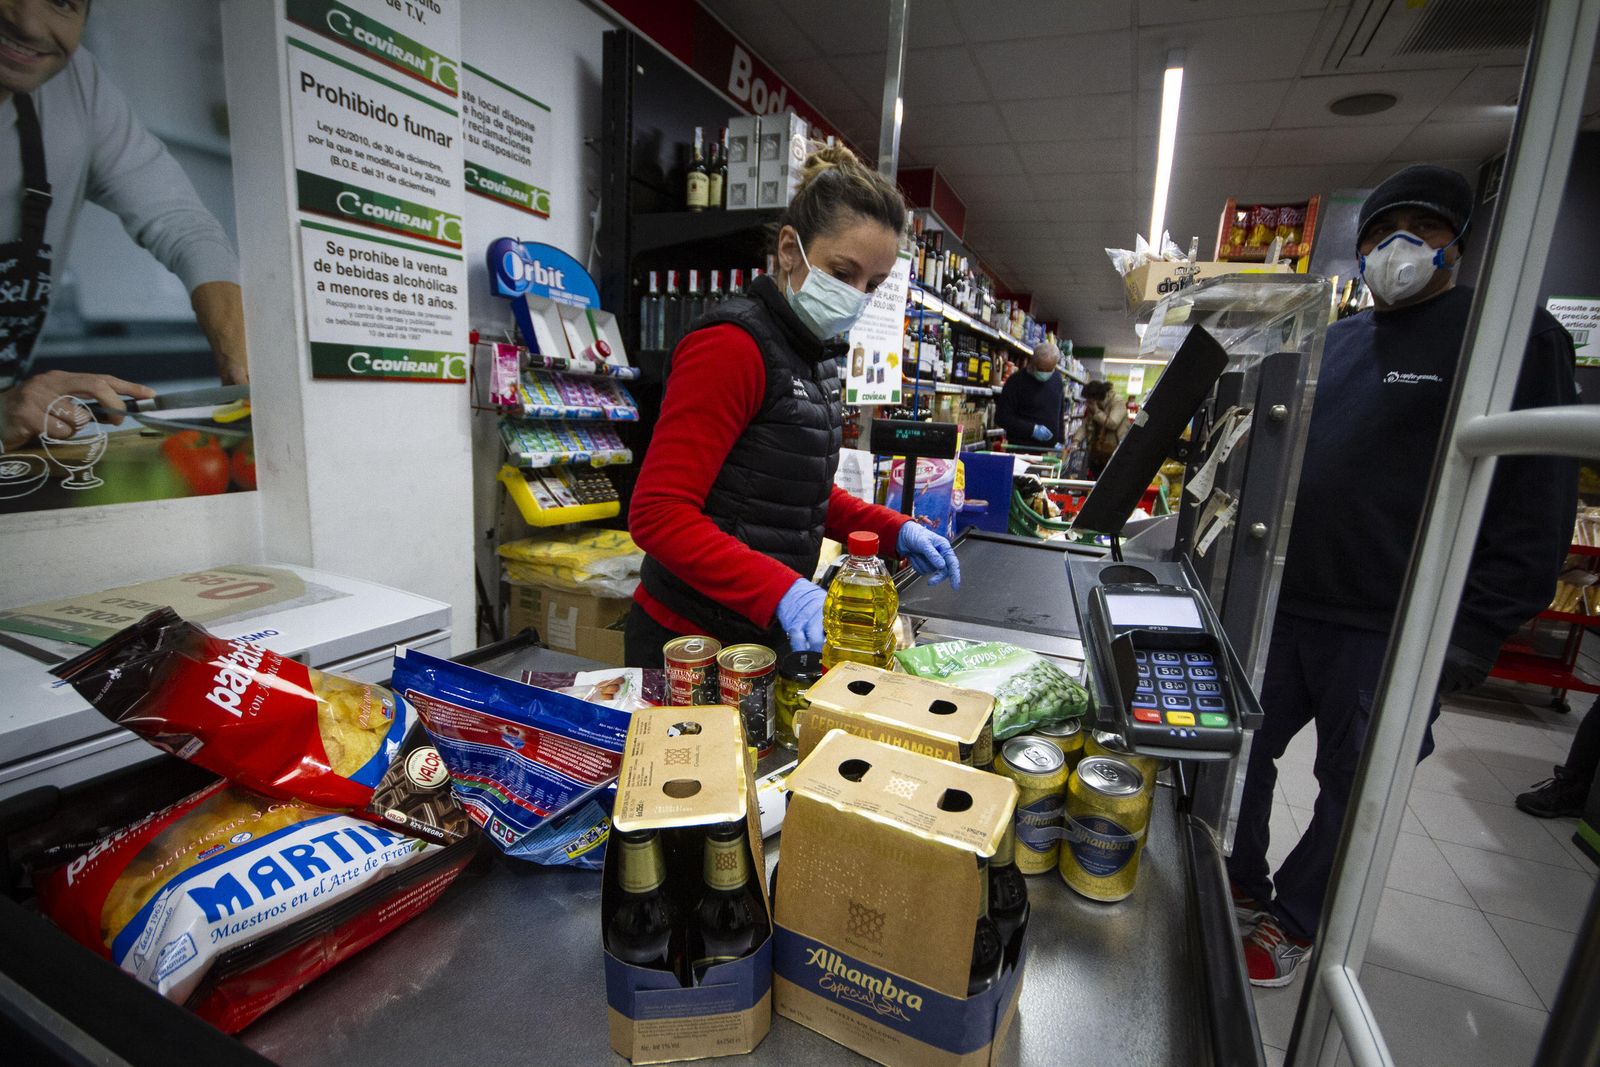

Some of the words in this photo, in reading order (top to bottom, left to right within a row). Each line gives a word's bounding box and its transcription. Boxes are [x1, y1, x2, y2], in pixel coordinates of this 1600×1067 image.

[300, 70, 398, 128] Prohibido
[403, 114, 453, 149] fumar
[471, 106, 491, 124] hoja
[493, 118, 504, 129] de
[506, 125, 534, 144] quejas
[478, 96, 500, 116] local
[502, 109, 536, 132] dispone
[316, 120, 333, 136] Ley
[372, 141, 383, 152] de
[395, 147, 405, 158] de
[468, 120, 532, 154] reclamaciones
[468, 133, 480, 145] su
[308, 134, 324, 146] por
[326, 138, 334, 150] la
[336, 144, 353, 157] que
[354, 150, 365, 160] se
[366, 152, 400, 171] modifica
[401, 164, 409, 174] la
[410, 166, 423, 181] Ley
[361, 164, 374, 177] del
[375, 168, 385, 180] 31
[387, 173, 397, 184] de
[313, 257, 332, 274] de
[336, 260, 390, 284] bebidas
[393, 273, 458, 296] alcohólicas
[325, 240, 344, 257] Se
[349, 247, 400, 269] prohibe
[402, 256, 413, 270] la
[416, 261, 448, 277] venta
[502, 251, 565, 290] Orbit
[316, 280, 326, 292] a
[330, 282, 389, 302] menores
[393, 289, 408, 304] de
[411, 293, 425, 306] 18
[427, 296, 458, 311] años.
[1550, 303, 1588, 312] Consulte
[248, 695, 265, 717] con
[879, 732, 954, 763] ALHAMBRA
[416, 751, 441, 783] VALOR
[150, 817, 246, 878] Deliciosas
[409, 821, 422, 831] 82%
[422, 825, 444, 839] NEGRO
[209, 904, 288, 944] Maestros
[291, 889, 310, 908] en
[312, 877, 327, 898] el
[328, 864, 360, 895] Arte
[363, 856, 379, 873] de
[804, 948, 924, 1012] Alhambra
[817, 973, 877, 1004] Especial
